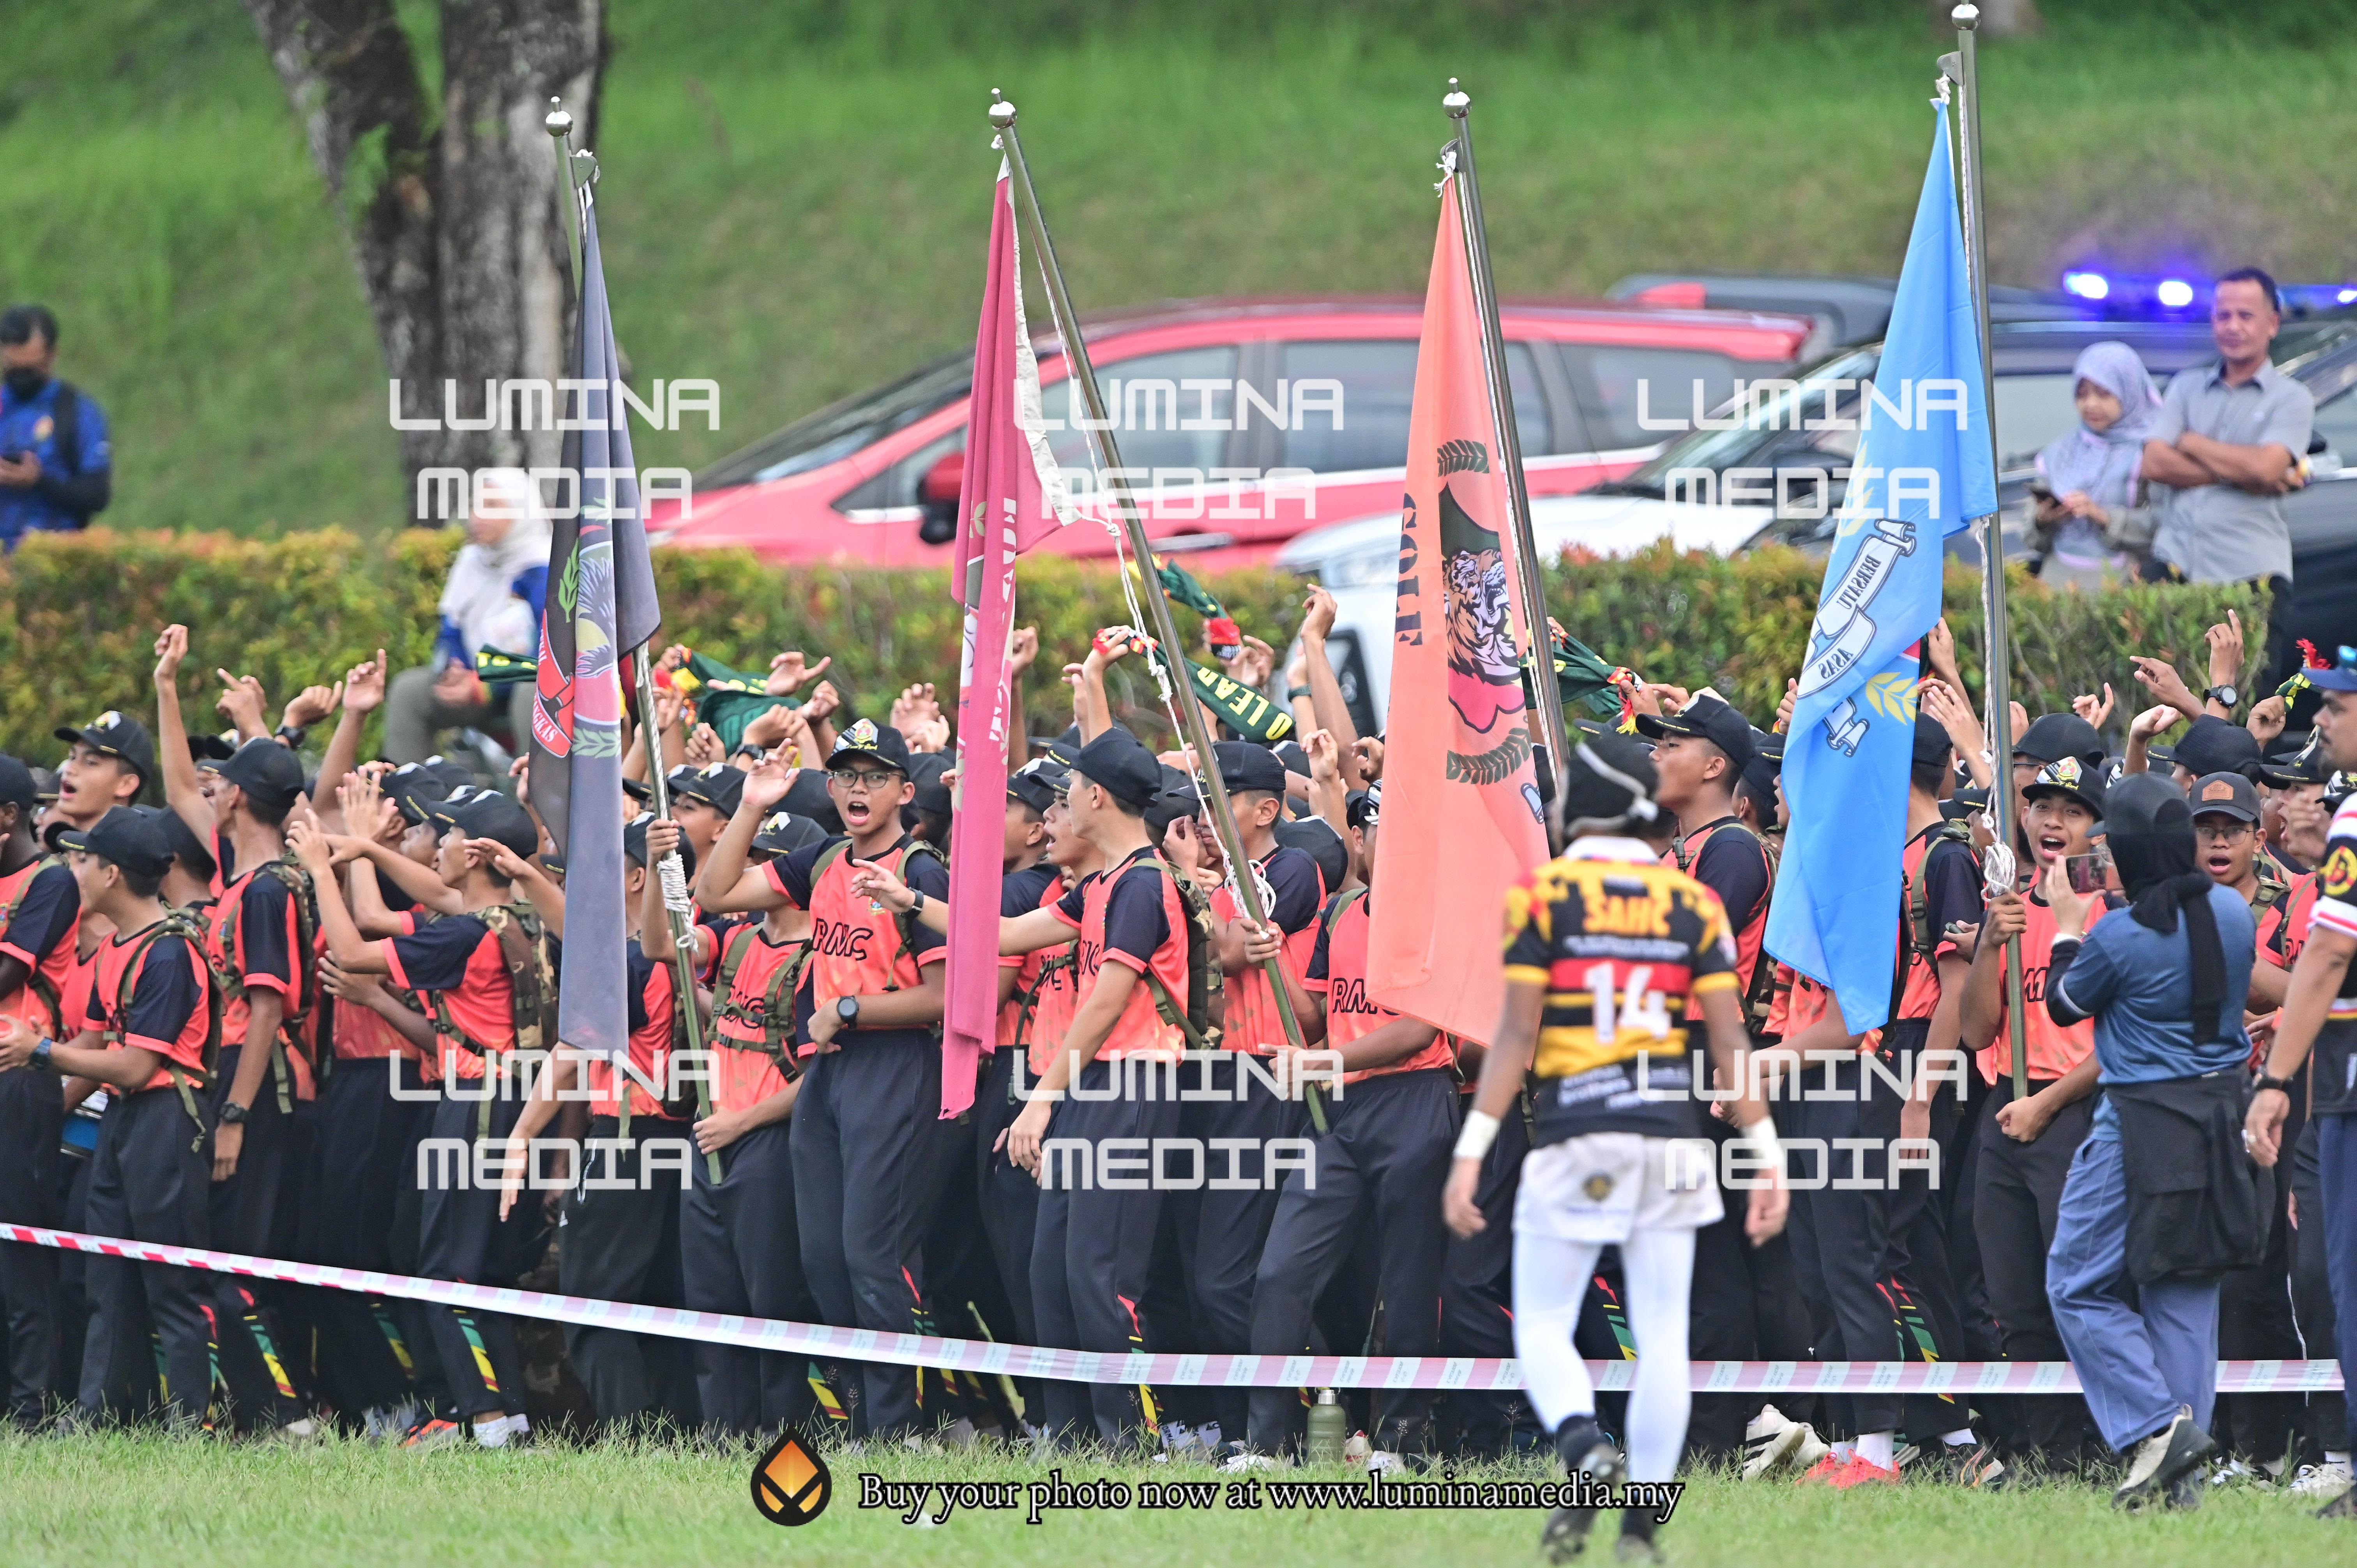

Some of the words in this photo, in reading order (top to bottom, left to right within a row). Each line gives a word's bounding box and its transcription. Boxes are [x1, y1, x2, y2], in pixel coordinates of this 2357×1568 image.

[1197, 667, 1270, 727] LEAD
[813, 917, 874, 961] RMC
[1332, 977, 1400, 1015] RM
[1583, 961, 1674, 1045] 14
